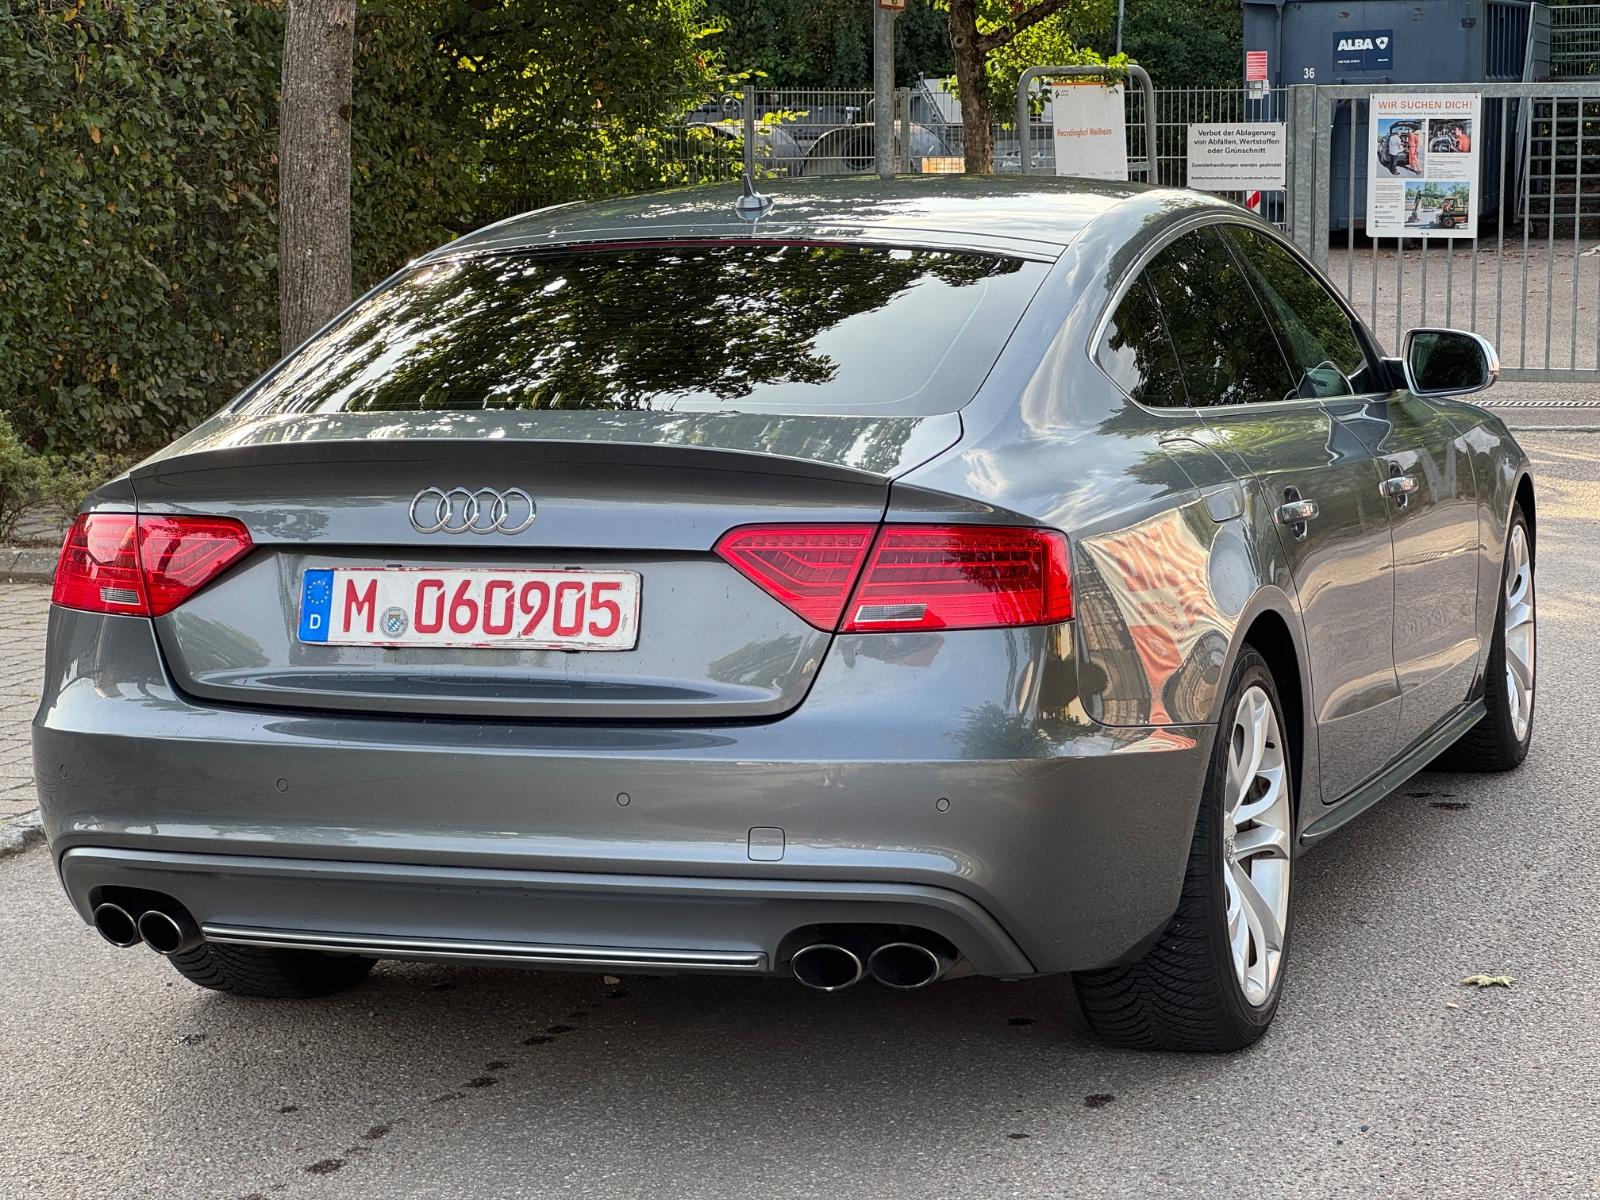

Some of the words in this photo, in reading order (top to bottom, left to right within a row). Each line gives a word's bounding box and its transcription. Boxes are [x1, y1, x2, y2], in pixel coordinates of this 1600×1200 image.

[1337, 38, 1374, 51] ALBA
[1303, 67, 1315, 79] 36
[1378, 101, 1397, 109] WIR
[1400, 101, 1441, 109] SUCHEN
[1198, 129, 1221, 137] Verbot
[1236, 129, 1276, 137] Ablagerung
[343, 579, 377, 632] M
[414, 579, 622, 637] 060905
[308, 614, 321, 630] D
